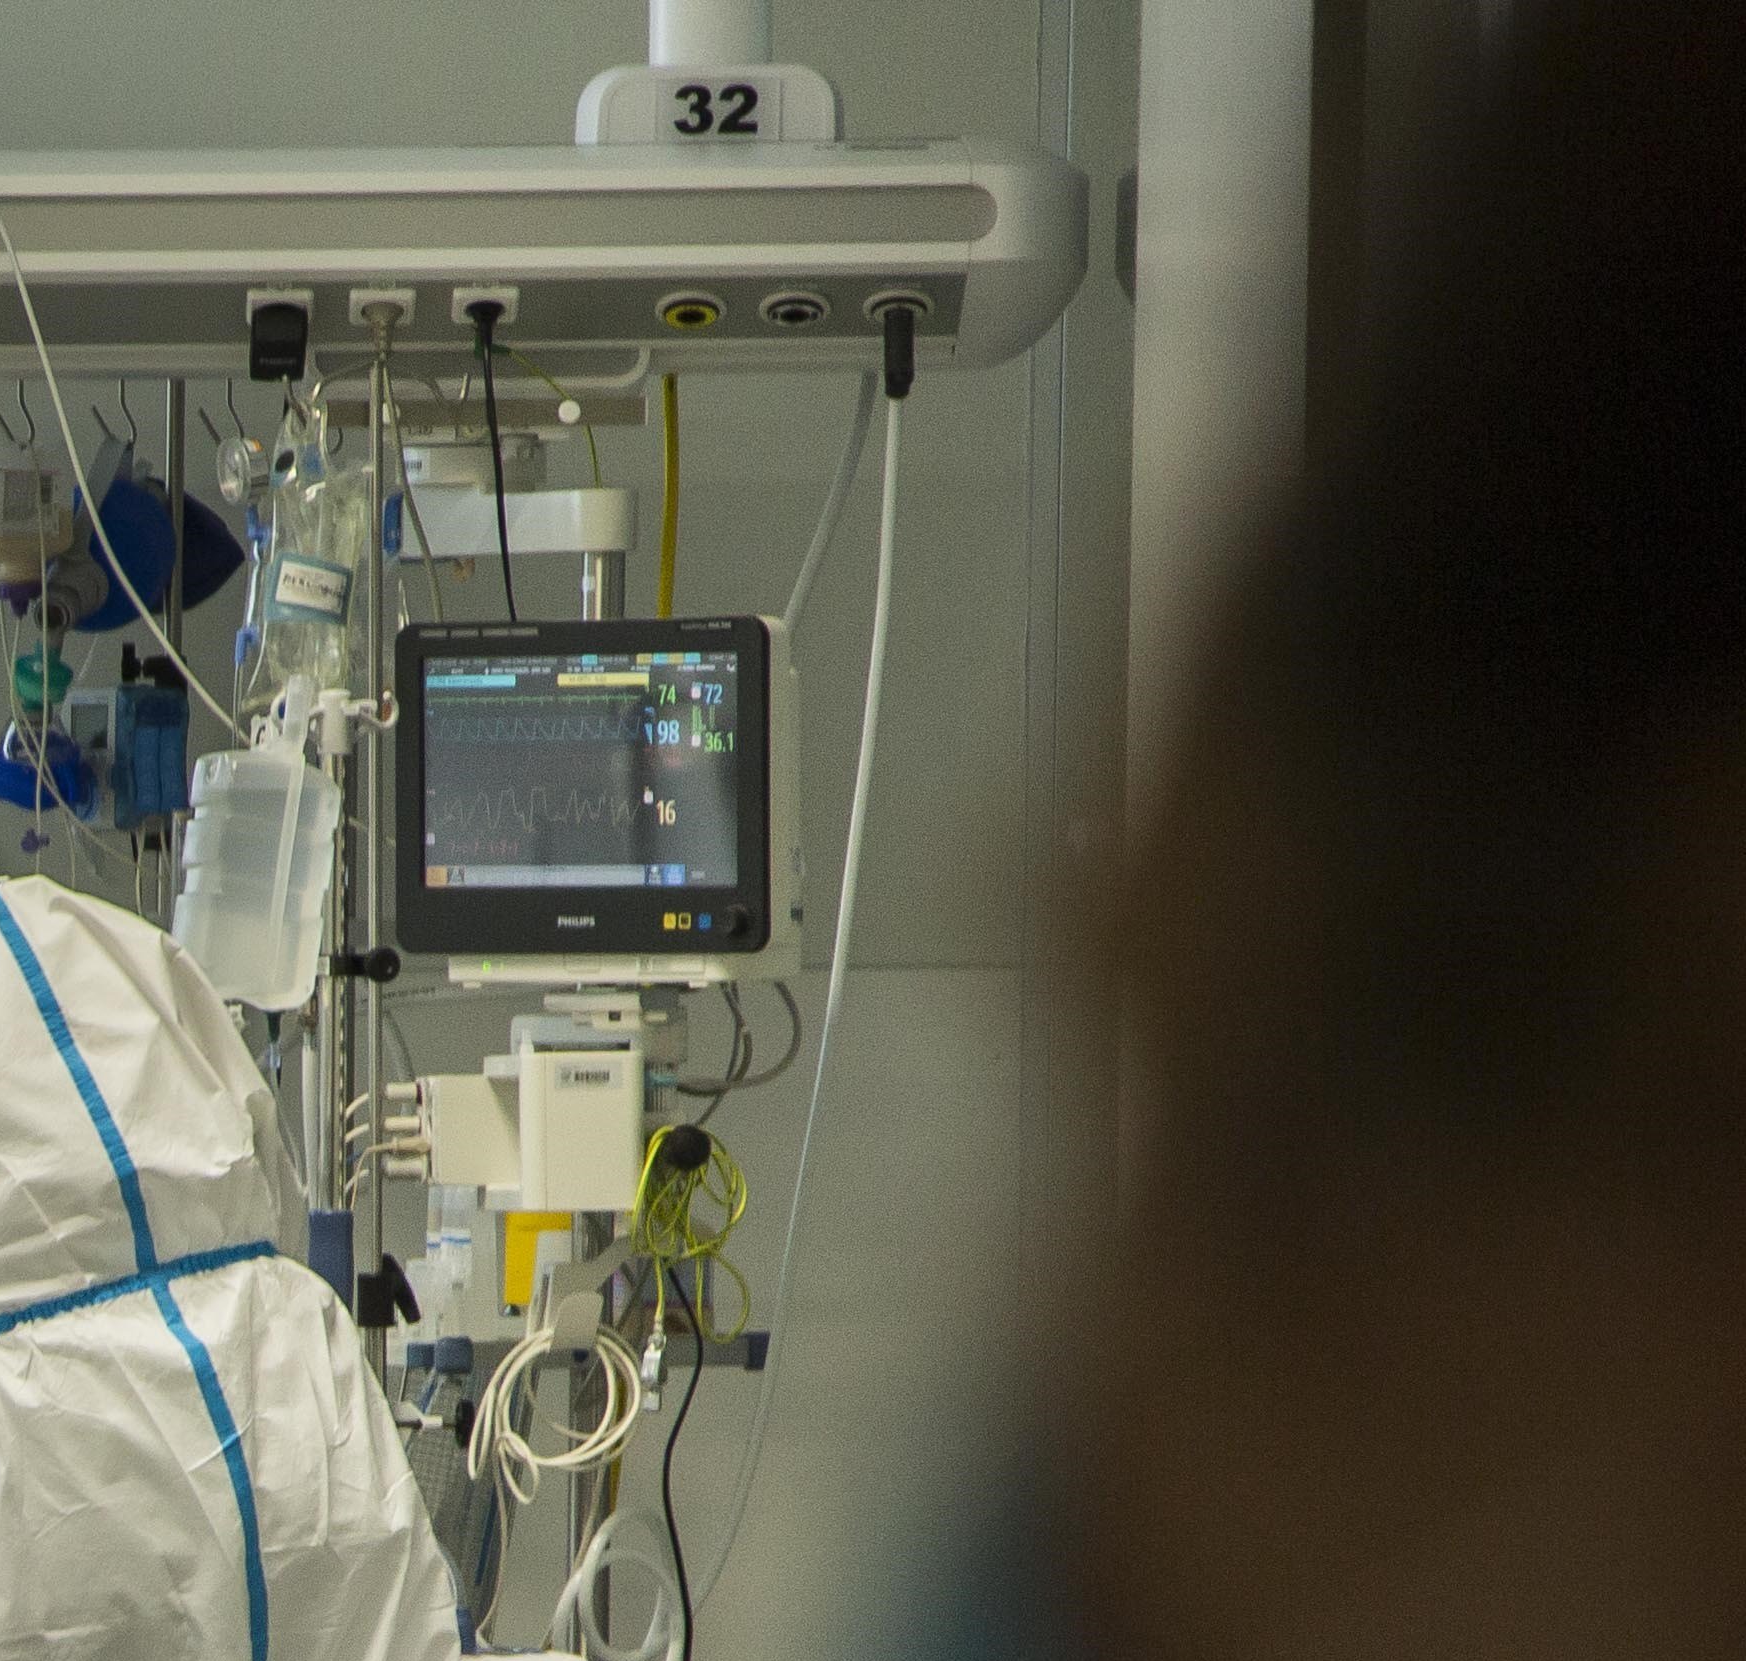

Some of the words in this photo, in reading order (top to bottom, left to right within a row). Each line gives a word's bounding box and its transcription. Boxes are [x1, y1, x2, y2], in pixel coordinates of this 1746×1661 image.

[673, 83, 759, 135] 32
[658, 683, 677, 706] 74
[705, 682, 723, 705] 72
[657, 718, 681, 746] 98
[704, 731, 735, 753] 36.1
[657, 800, 677, 827] 16
[557, 915, 596, 928] PHILIPS
